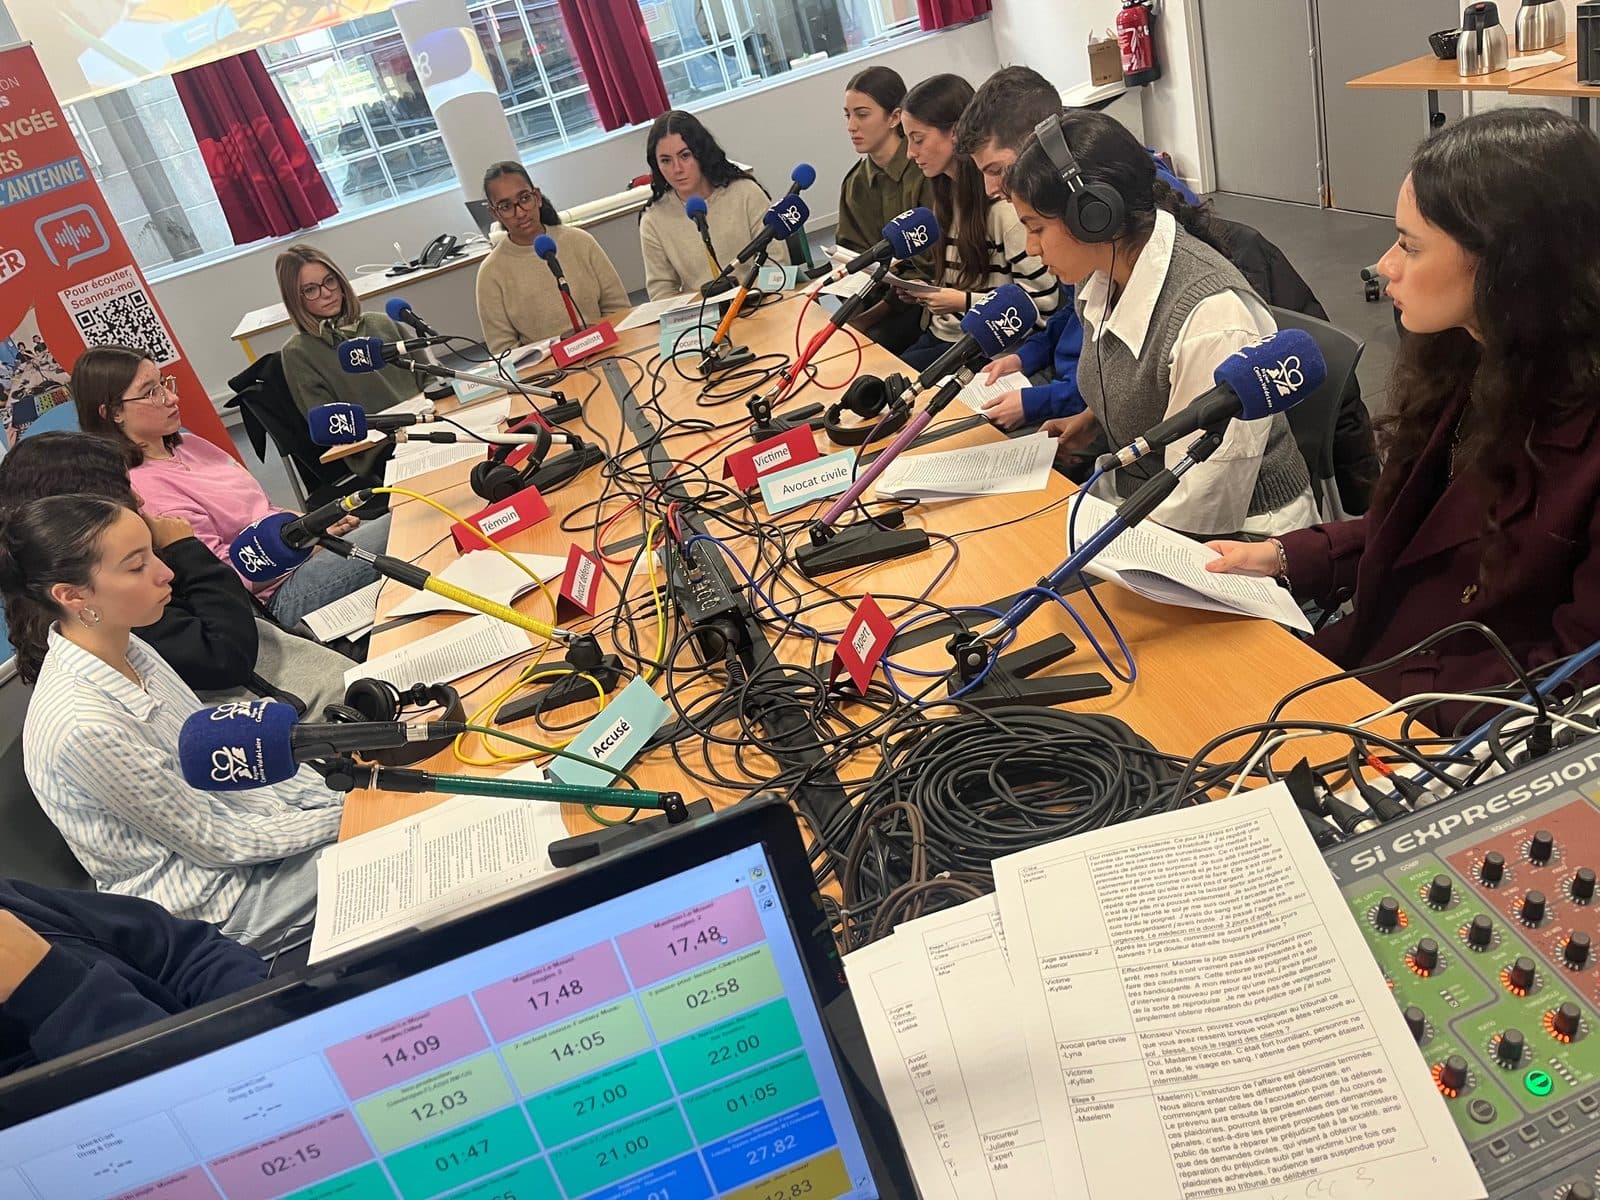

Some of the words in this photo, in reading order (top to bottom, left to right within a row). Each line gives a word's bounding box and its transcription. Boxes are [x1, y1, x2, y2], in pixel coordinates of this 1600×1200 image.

[0, 76, 20, 92] ON
[0, 149, 23, 174] ES
[64, 286, 91, 299] Pour
[92, 269, 132, 290] écouter,
[71, 280, 137, 310] Scannez-moi
[567, 333, 602, 354] Journaliste
[755, 447, 789, 467] Victime
[782, 476, 818, 495] Avocat
[820, 468, 848, 483] civile
[482, 511, 517, 532] Témoin
[592, 719, 630, 759] Accusé
[1350, 846, 1387, 872] Si
[666, 925, 721, 957] 17,48
[686, 977, 740, 1010] 02:58
[1045, 977, 1071, 985] Victime
[527, 979, 584, 1011] 17,48
[382, 1034, 441, 1068] 14,09
[550, 1030, 606, 1063] 14:05
[1062, 1051, 1083, 1059] -Lyna
[1086, 1039, 1107, 1049] partie
[1108, 1036, 1127, 1044] civile
[1065, 1069, 1093, 1077] Victime
[1068, 1077, 1095, 1087] -Kyllian
[410, 1090, 468, 1122] 12,03
[726, 1082, 778, 1114] 01:05
[1074, 1103, 1115, 1114] Journaliste
[983, 1129, 1019, 1143] Procureur
[261, 1143, 322, 1178] 02:15
[435, 1139, 490, 1173] 01:47
[989, 1151, 1014, 1163] Expert
